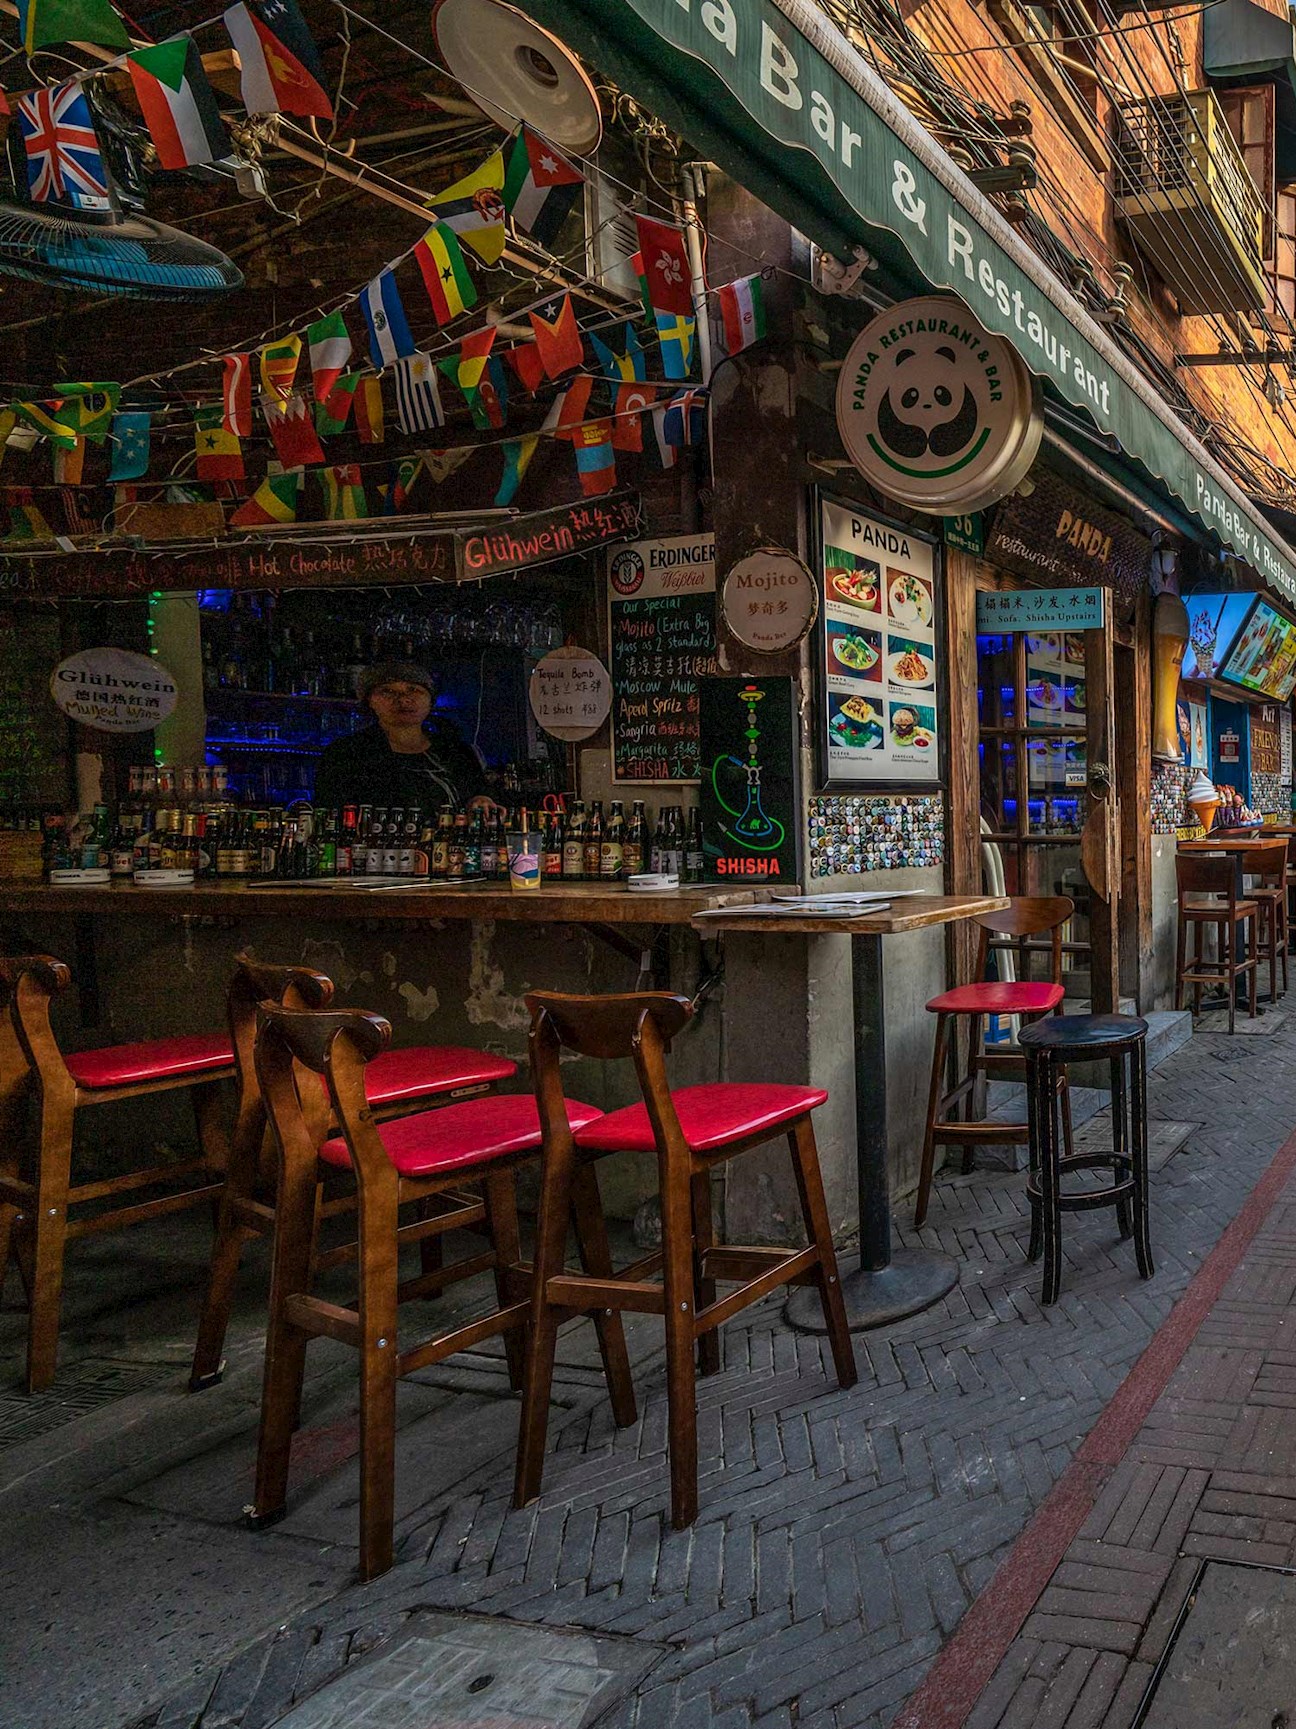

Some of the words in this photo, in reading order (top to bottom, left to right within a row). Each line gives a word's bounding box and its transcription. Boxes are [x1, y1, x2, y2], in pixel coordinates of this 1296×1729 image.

[759, 20, 861, 168] Bar
[892, 159, 928, 236] &
[947, 214, 1111, 415] Restaurant
[853, 351, 881, 411] PANDA
[879, 318, 981, 350] RESTAURANT
[977, 350, 990, 363] &
[985, 365, 1003, 402] BAR
[465, 524, 575, 568] Glühwein
[851, 518, 911, 560] PANDA
[1056, 509, 1114, 563] PANDA
[1233, 512, 1250, 549] Bar
[1253, 535, 1260, 561] &
[249, 552, 281, 577] Hot
[289, 550, 356, 575] Chocolate
[650, 545, 716, 568] ERDINGER
[661, 571, 705, 592] Weißbier
[737, 572, 798, 591] Mojito
[644, 597, 680, 616] Special
[748, 600, 788, 617] 梦奇多
[620, 619, 655, 639] Mojito
[695, 613, 710, 635] Big
[1026, 612, 1055, 622] Shisha
[1058, 612, 1097, 623] Upstairs
[642, 641, 653, 651] as
[655, 636, 662, 652] 2
[58, 670, 175, 693] Glühwein
[572, 667, 595, 679] Bomb
[619, 680, 662, 694] Moscow
[670, 680, 698, 694] Mule
[539, 704, 549, 715] 12
[553, 703, 573, 715] shots
[652, 697, 683, 717] Spritz
[620, 721, 657, 743] Sangria
[621, 743, 668, 759] Margarita
[627, 759, 670, 778] SHISHA
[716, 857, 780, 875] SHISHA
